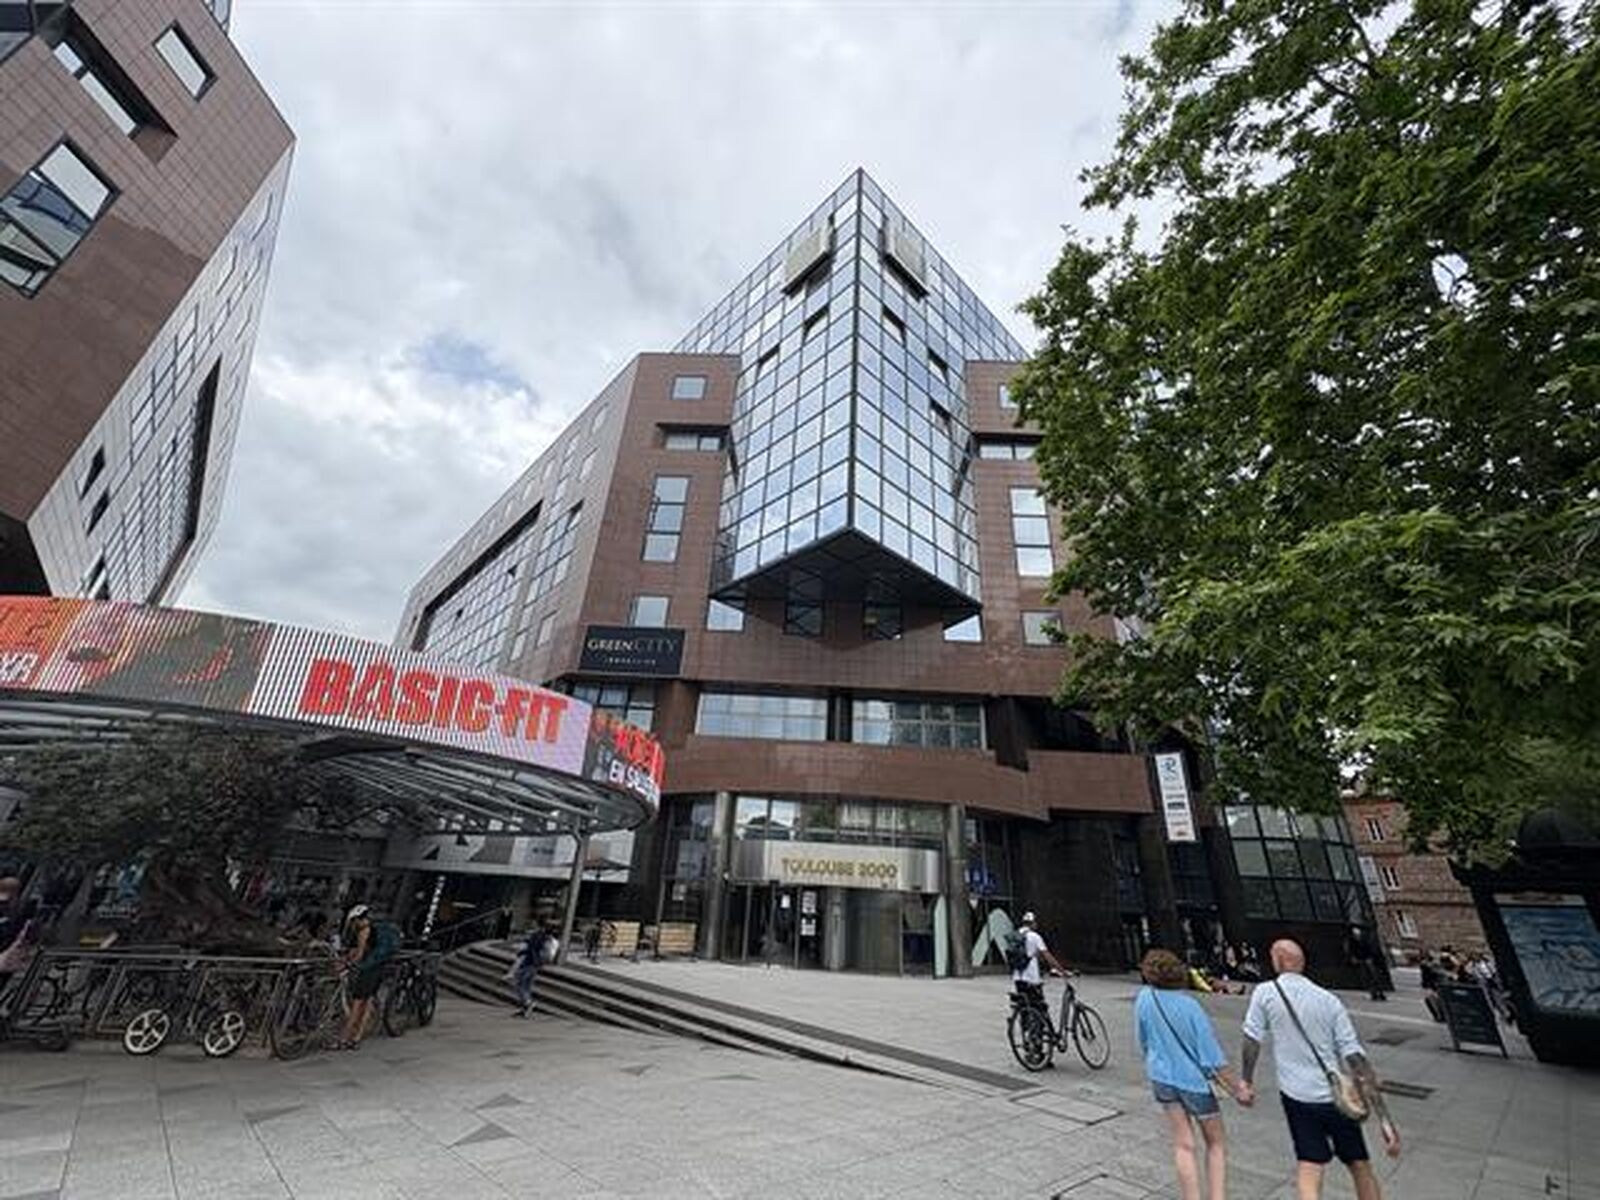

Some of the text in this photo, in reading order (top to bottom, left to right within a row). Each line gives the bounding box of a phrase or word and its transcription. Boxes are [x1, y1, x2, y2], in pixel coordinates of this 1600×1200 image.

[301, 656, 568, 743] BASIC-FIT
[782, 857, 898, 879] TOULOUSE 2000
